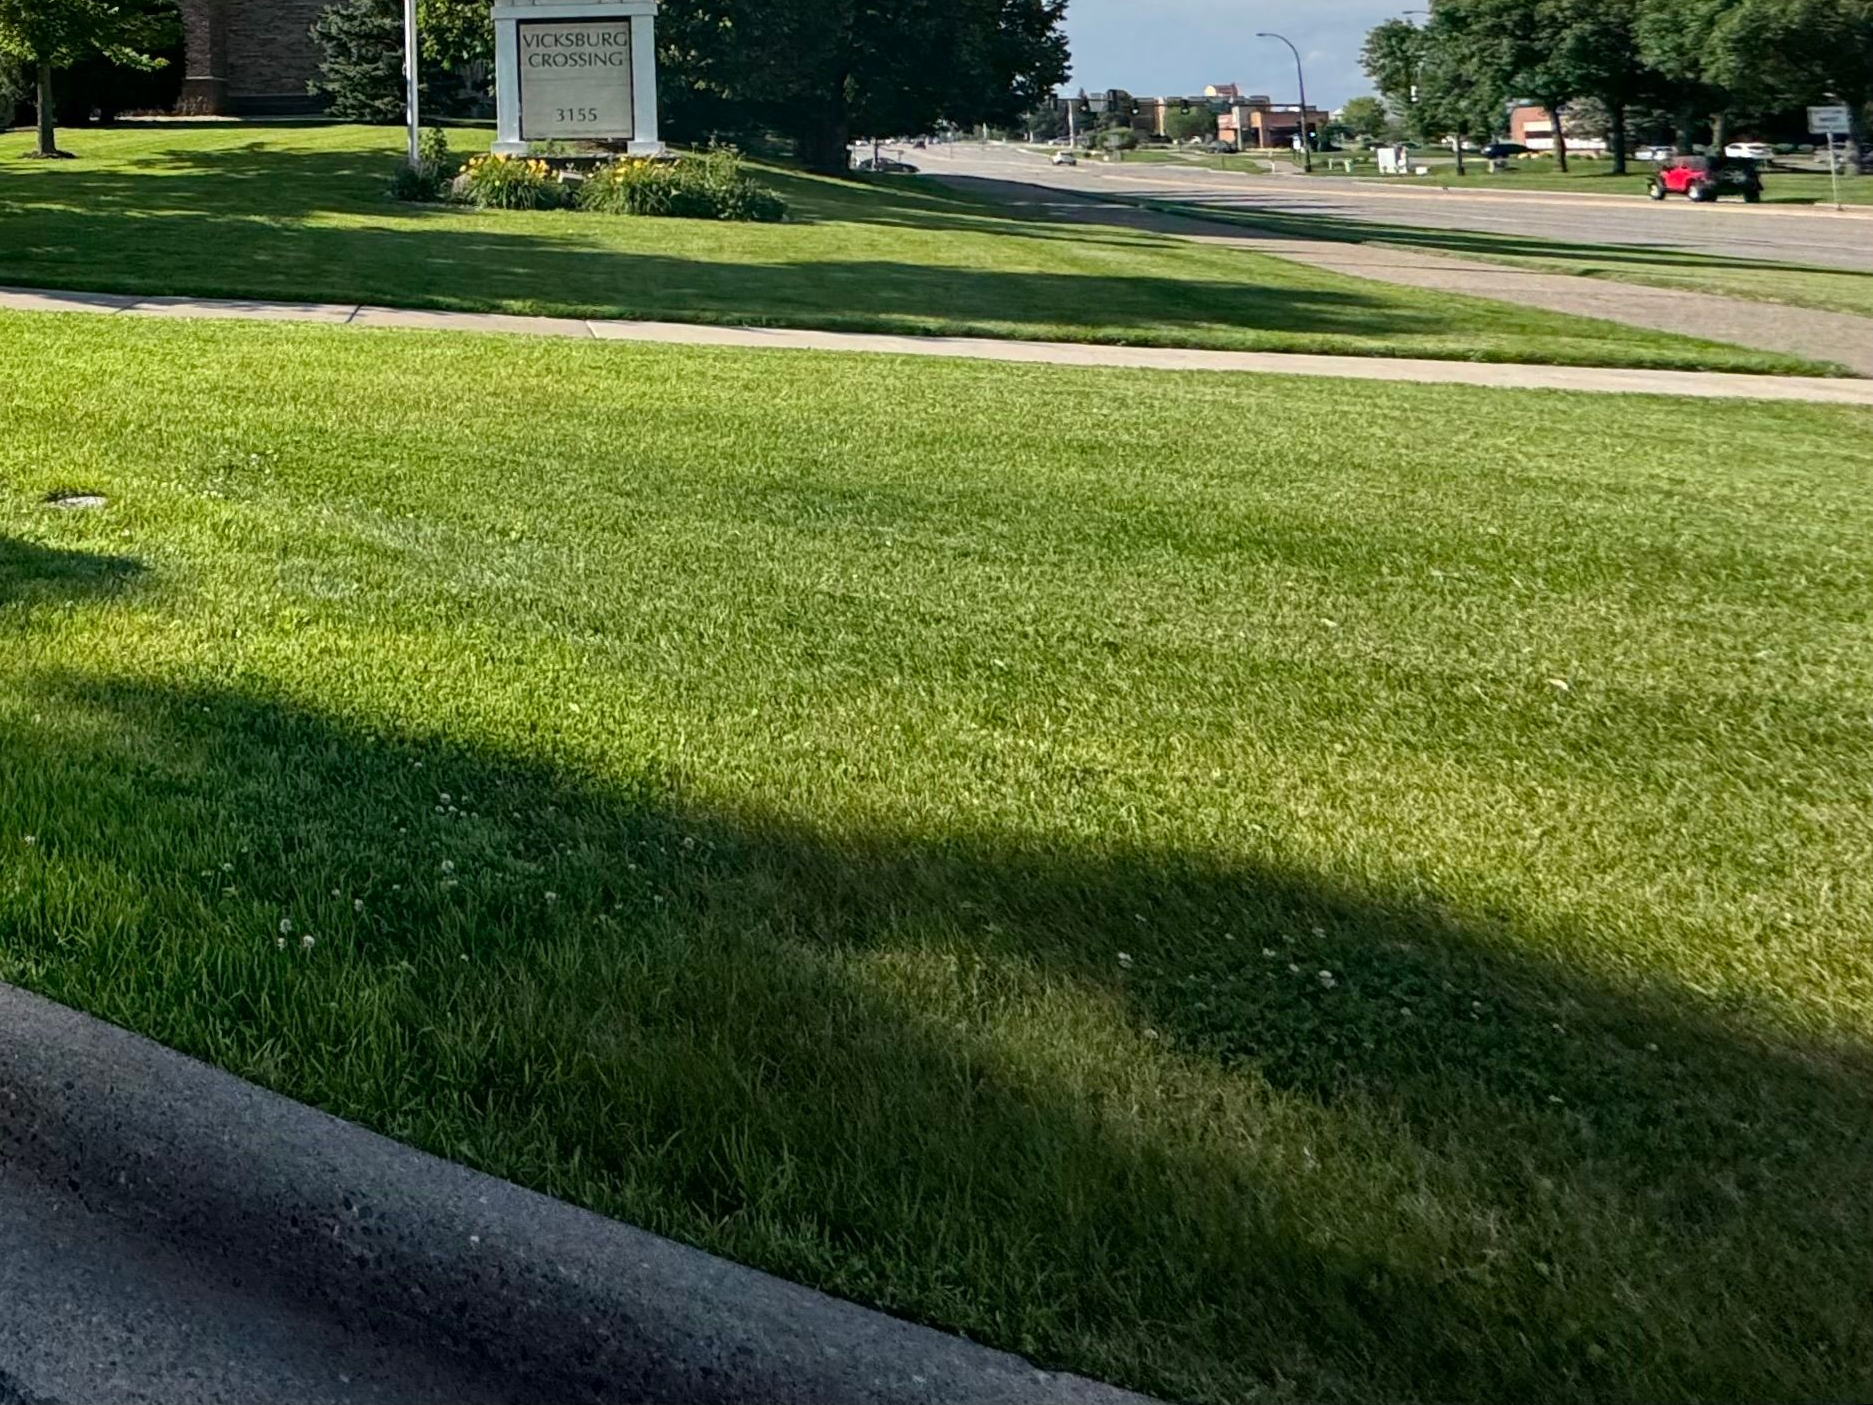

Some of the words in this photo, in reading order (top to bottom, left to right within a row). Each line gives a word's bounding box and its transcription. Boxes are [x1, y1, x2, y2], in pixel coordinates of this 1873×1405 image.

[522, 31, 628, 48] VICKSBURG
[528, 51, 623, 68] CROSSING
[556, 108, 598, 122] 3155
